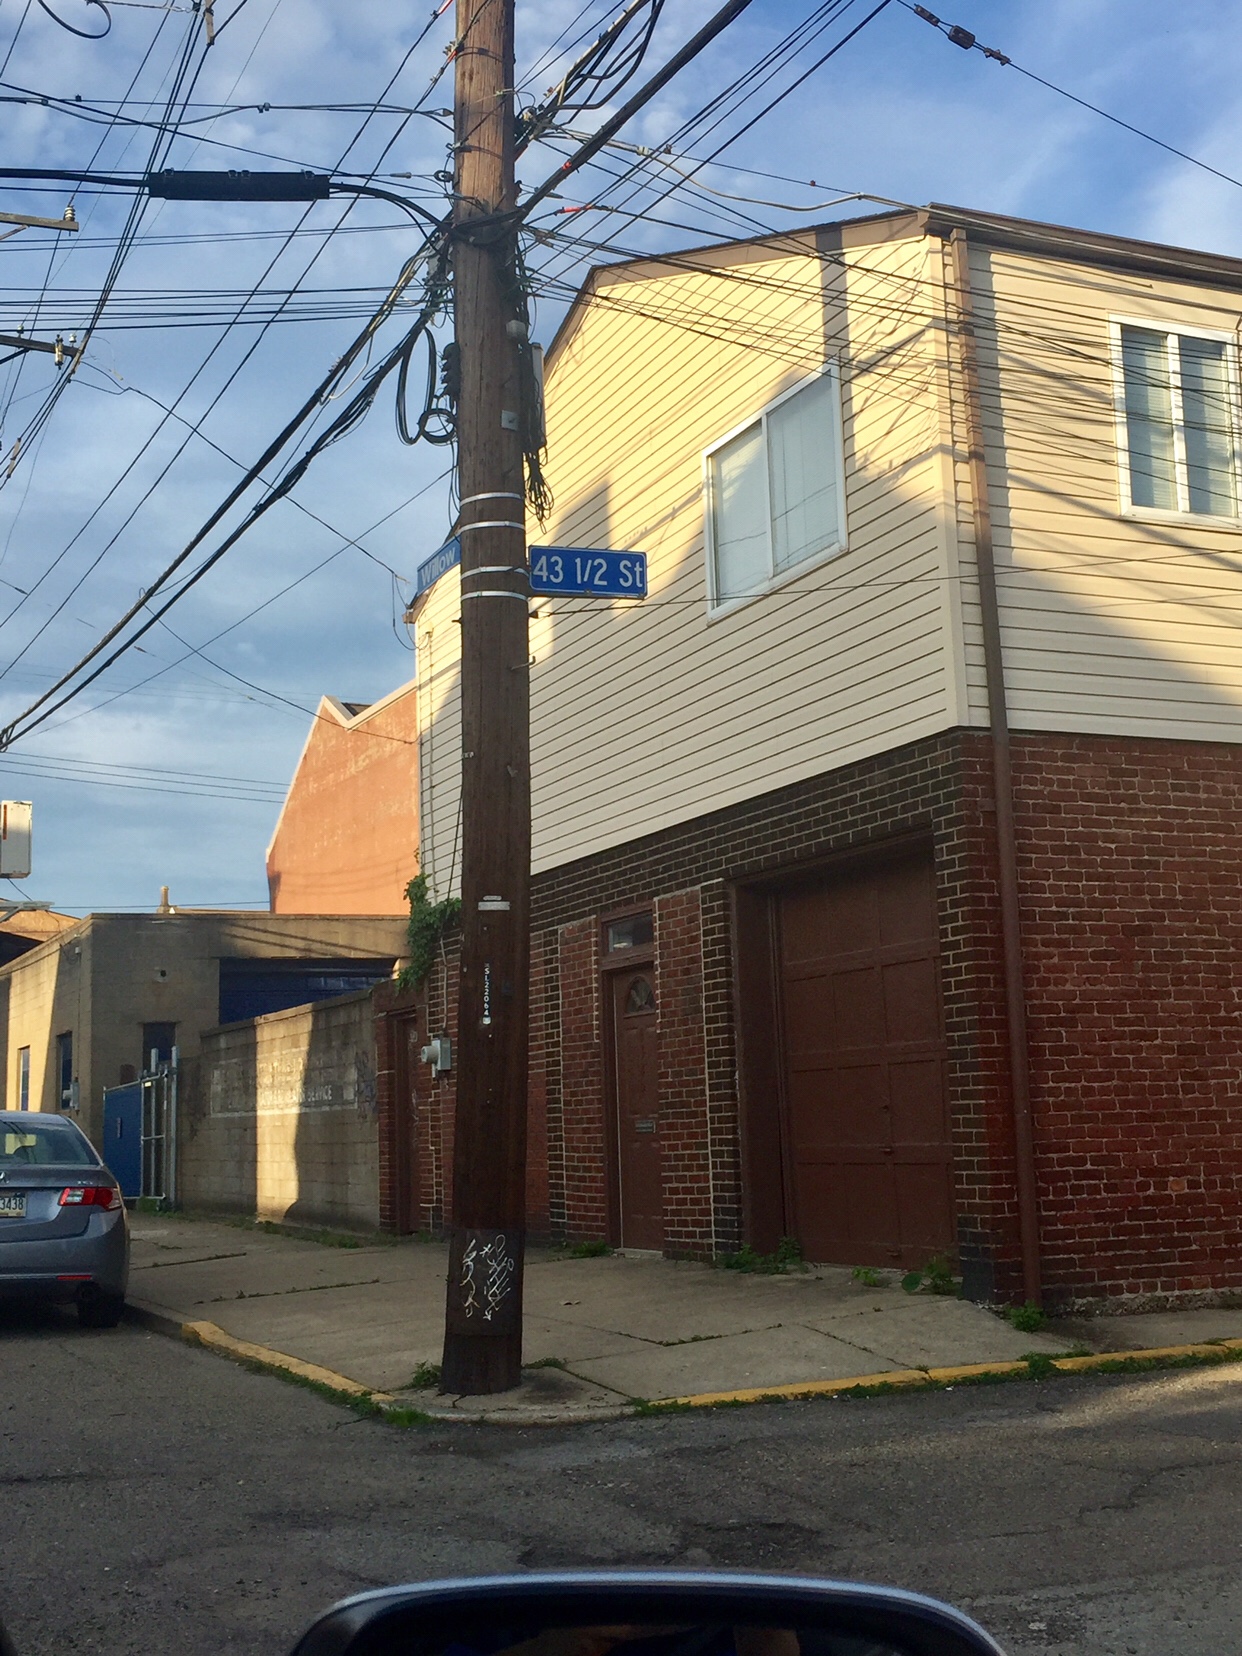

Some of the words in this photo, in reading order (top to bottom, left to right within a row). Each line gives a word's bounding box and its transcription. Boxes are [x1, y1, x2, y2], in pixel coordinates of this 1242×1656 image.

[421, 547, 456, 586] Willow
[532, 555, 564, 584] 43
[575, 557, 608, 586] 1/2
[619, 560, 643, 588] St
